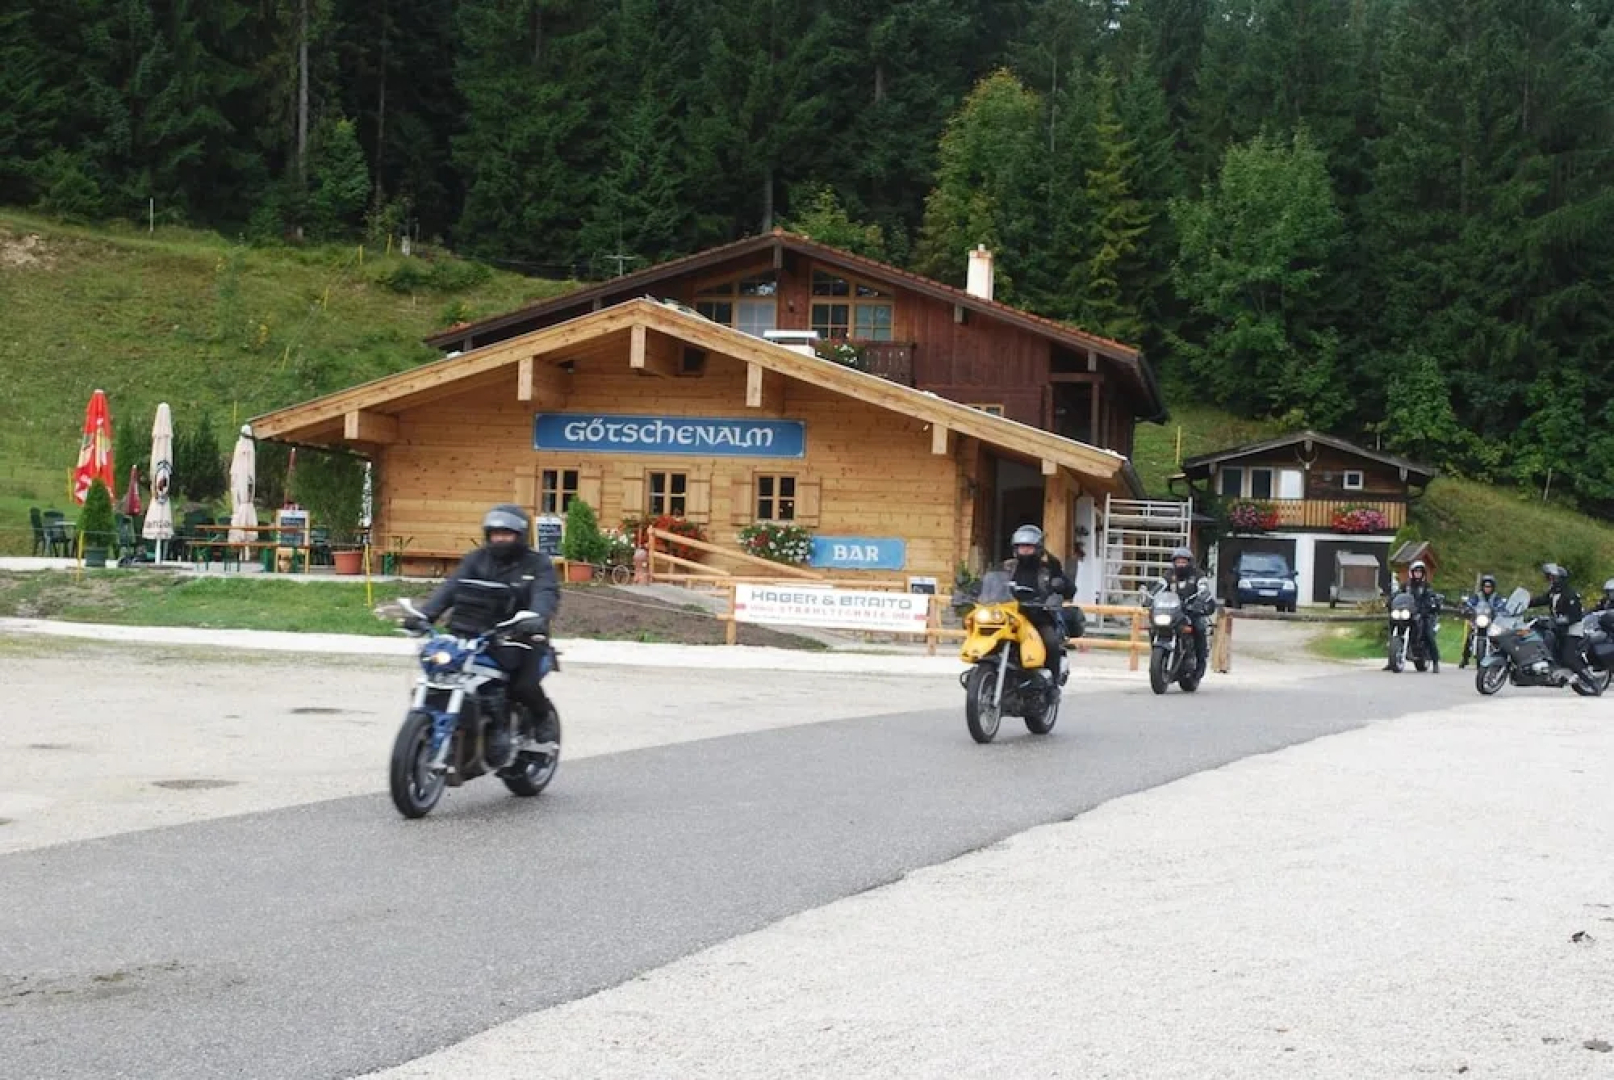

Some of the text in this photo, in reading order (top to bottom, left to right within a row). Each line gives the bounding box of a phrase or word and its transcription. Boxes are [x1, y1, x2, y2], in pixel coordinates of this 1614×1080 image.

[832, 545, 879, 561] BAR
[751, 590, 912, 609] HAGER & BRAITO
